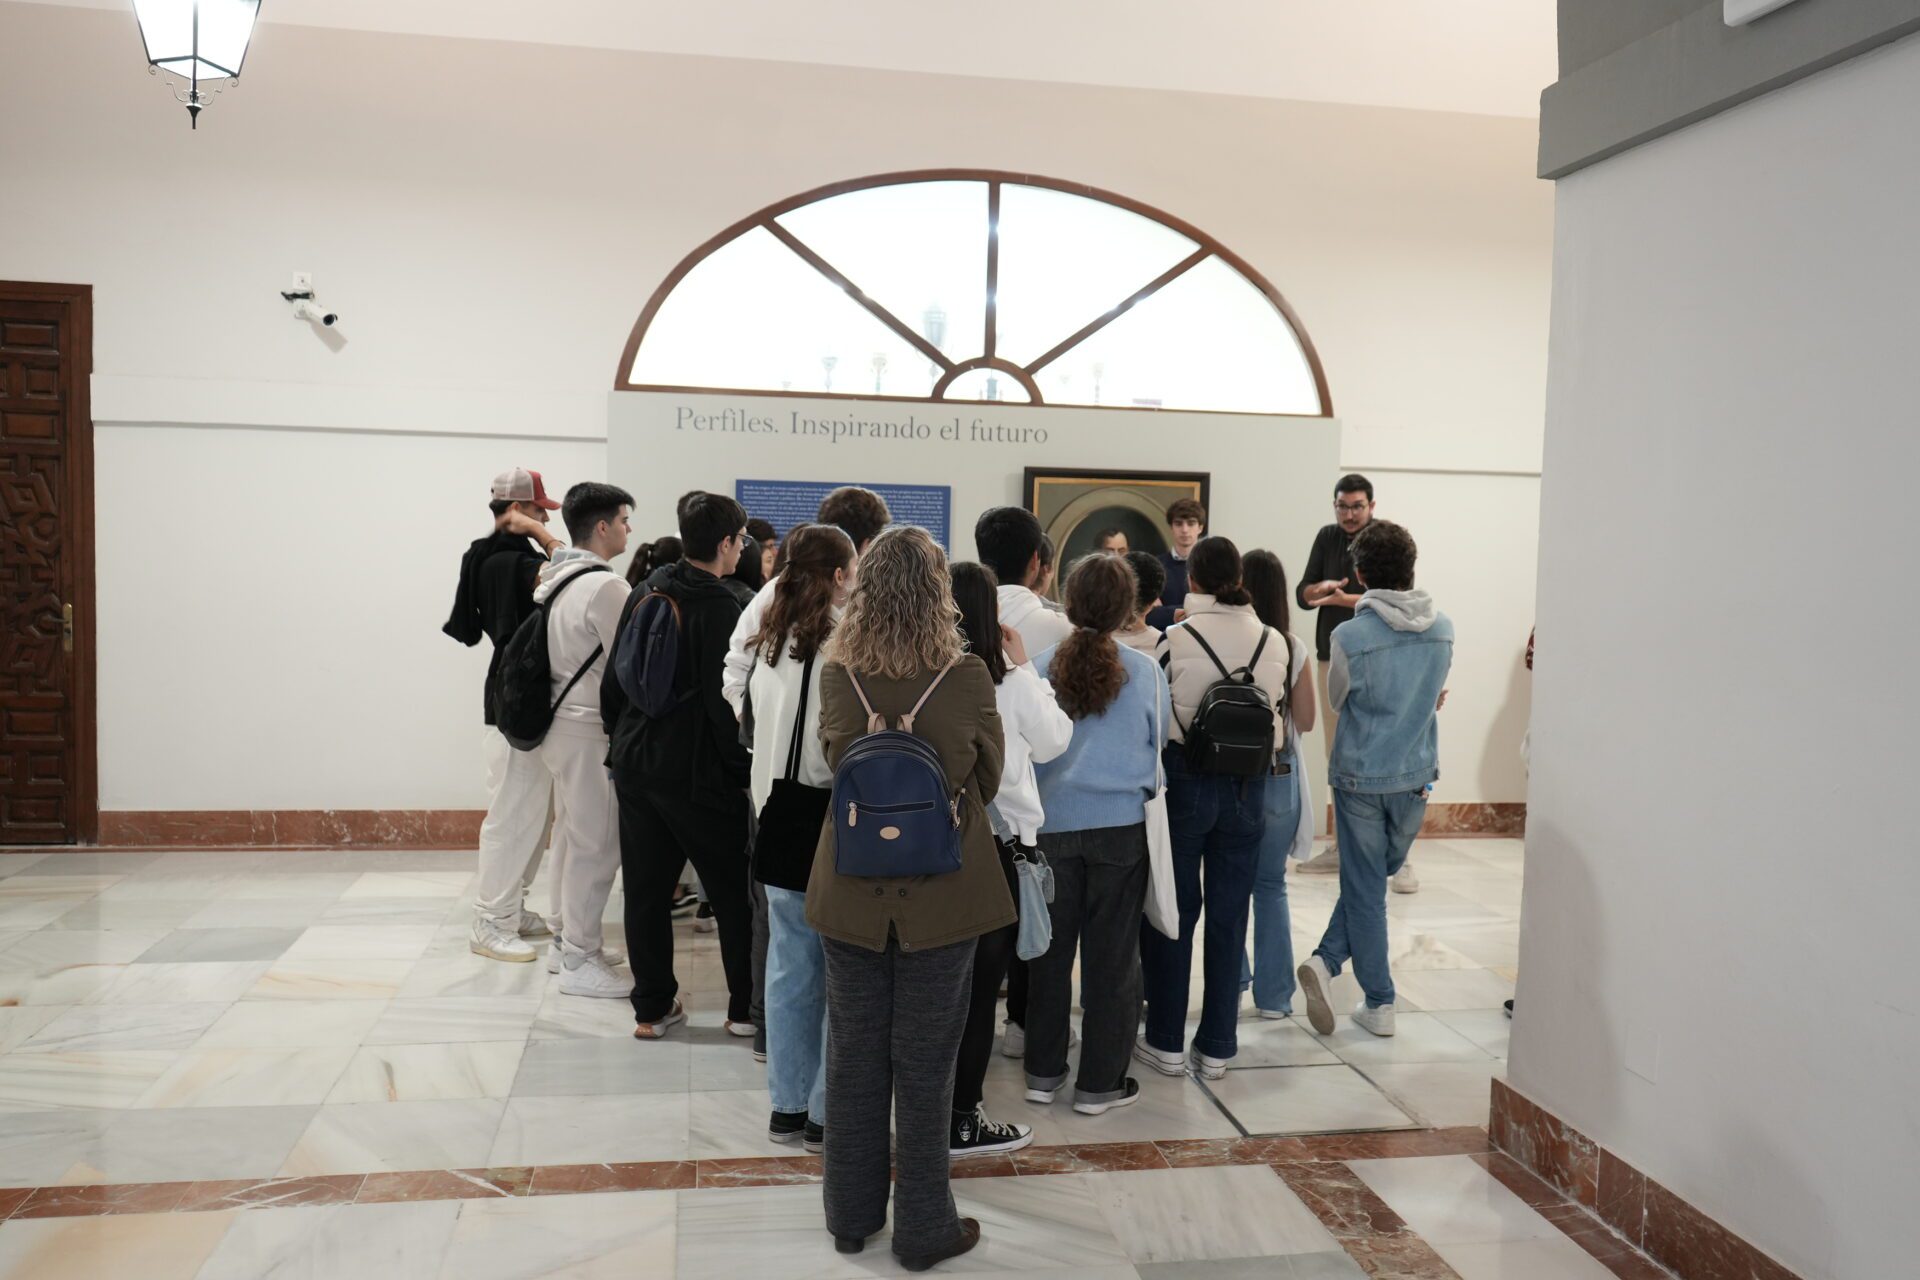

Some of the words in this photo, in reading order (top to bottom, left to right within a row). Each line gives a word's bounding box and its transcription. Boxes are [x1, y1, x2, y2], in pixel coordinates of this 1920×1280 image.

[676, 406, 779, 434] Perfiles.
[791, 411, 932, 444] Inspirando
[939, 417, 961, 442] el
[970, 419, 1049, 444] futuro
